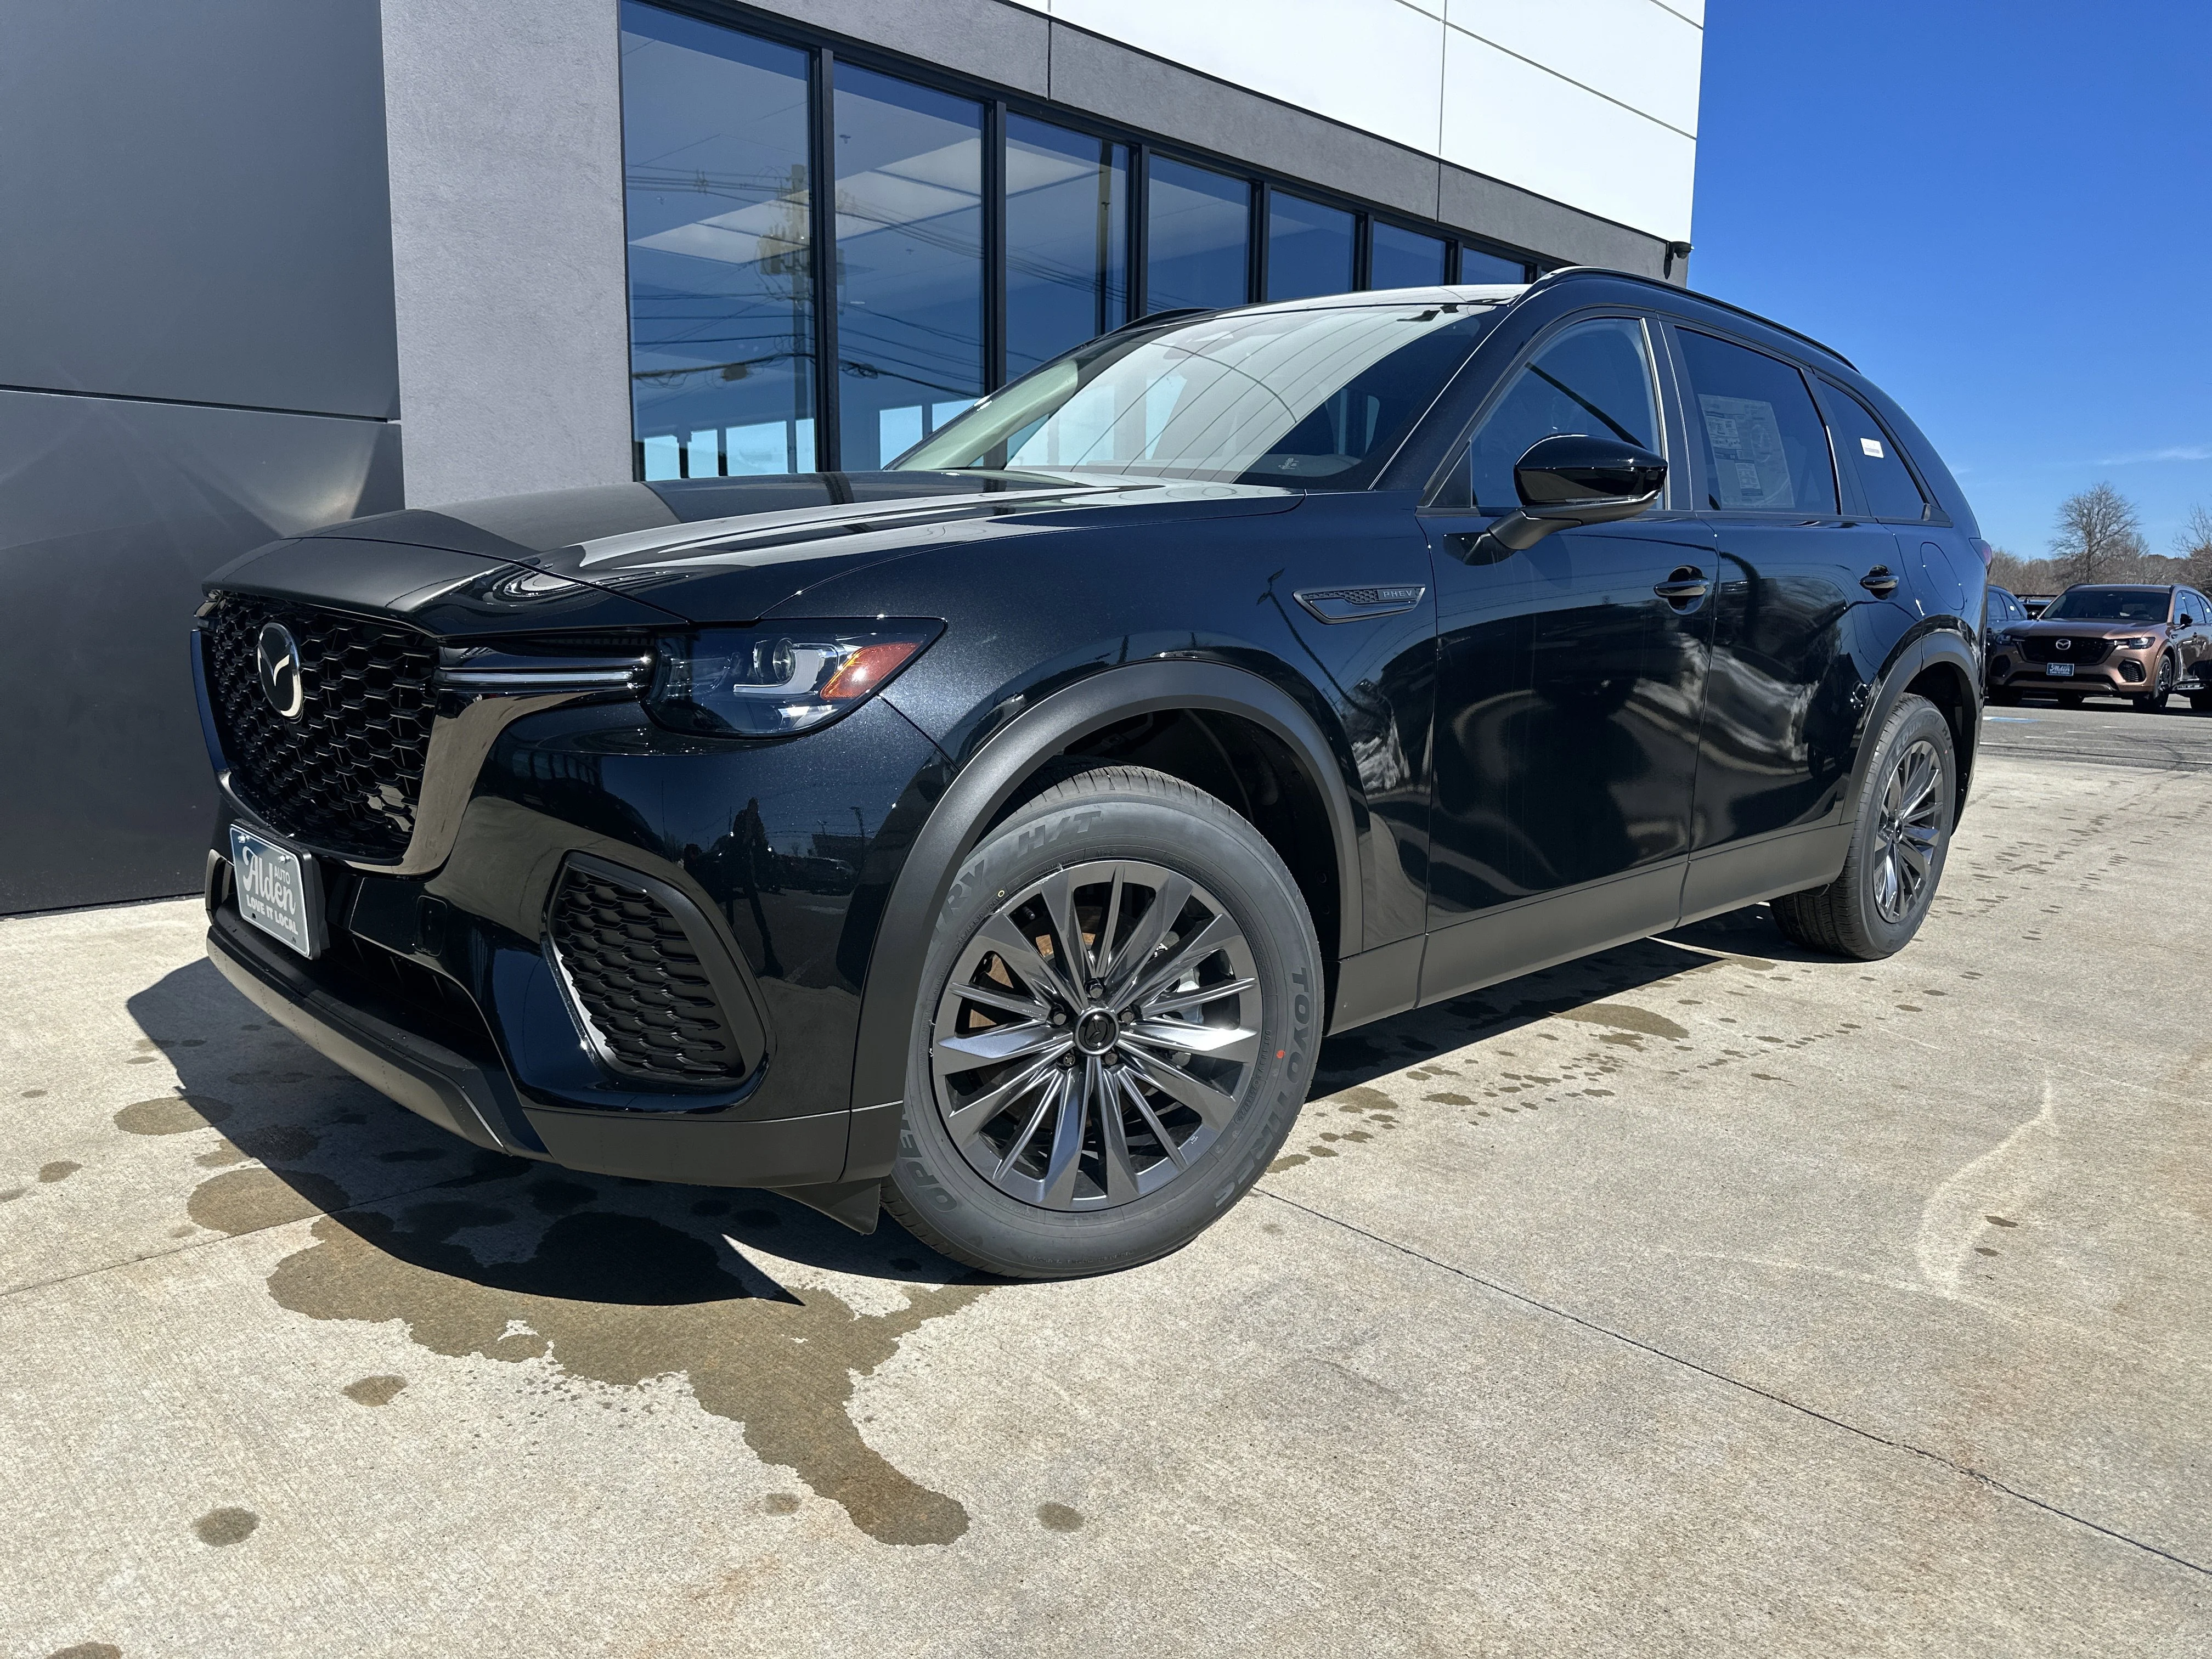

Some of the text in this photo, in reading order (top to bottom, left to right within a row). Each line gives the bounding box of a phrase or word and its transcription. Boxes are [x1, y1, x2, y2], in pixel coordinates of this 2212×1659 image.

[1383, 590, 1412, 598] PHEV
[1017, 810, 1102, 858] H/T
[241, 846, 297, 915] Alden
[274, 865, 291, 885] AUTO
[246, 894, 298, 935] LOVE IT LOCAL
[1287, 967, 1310, 1084] TOYO
[1215, 1090, 1292, 1208] TIRES
